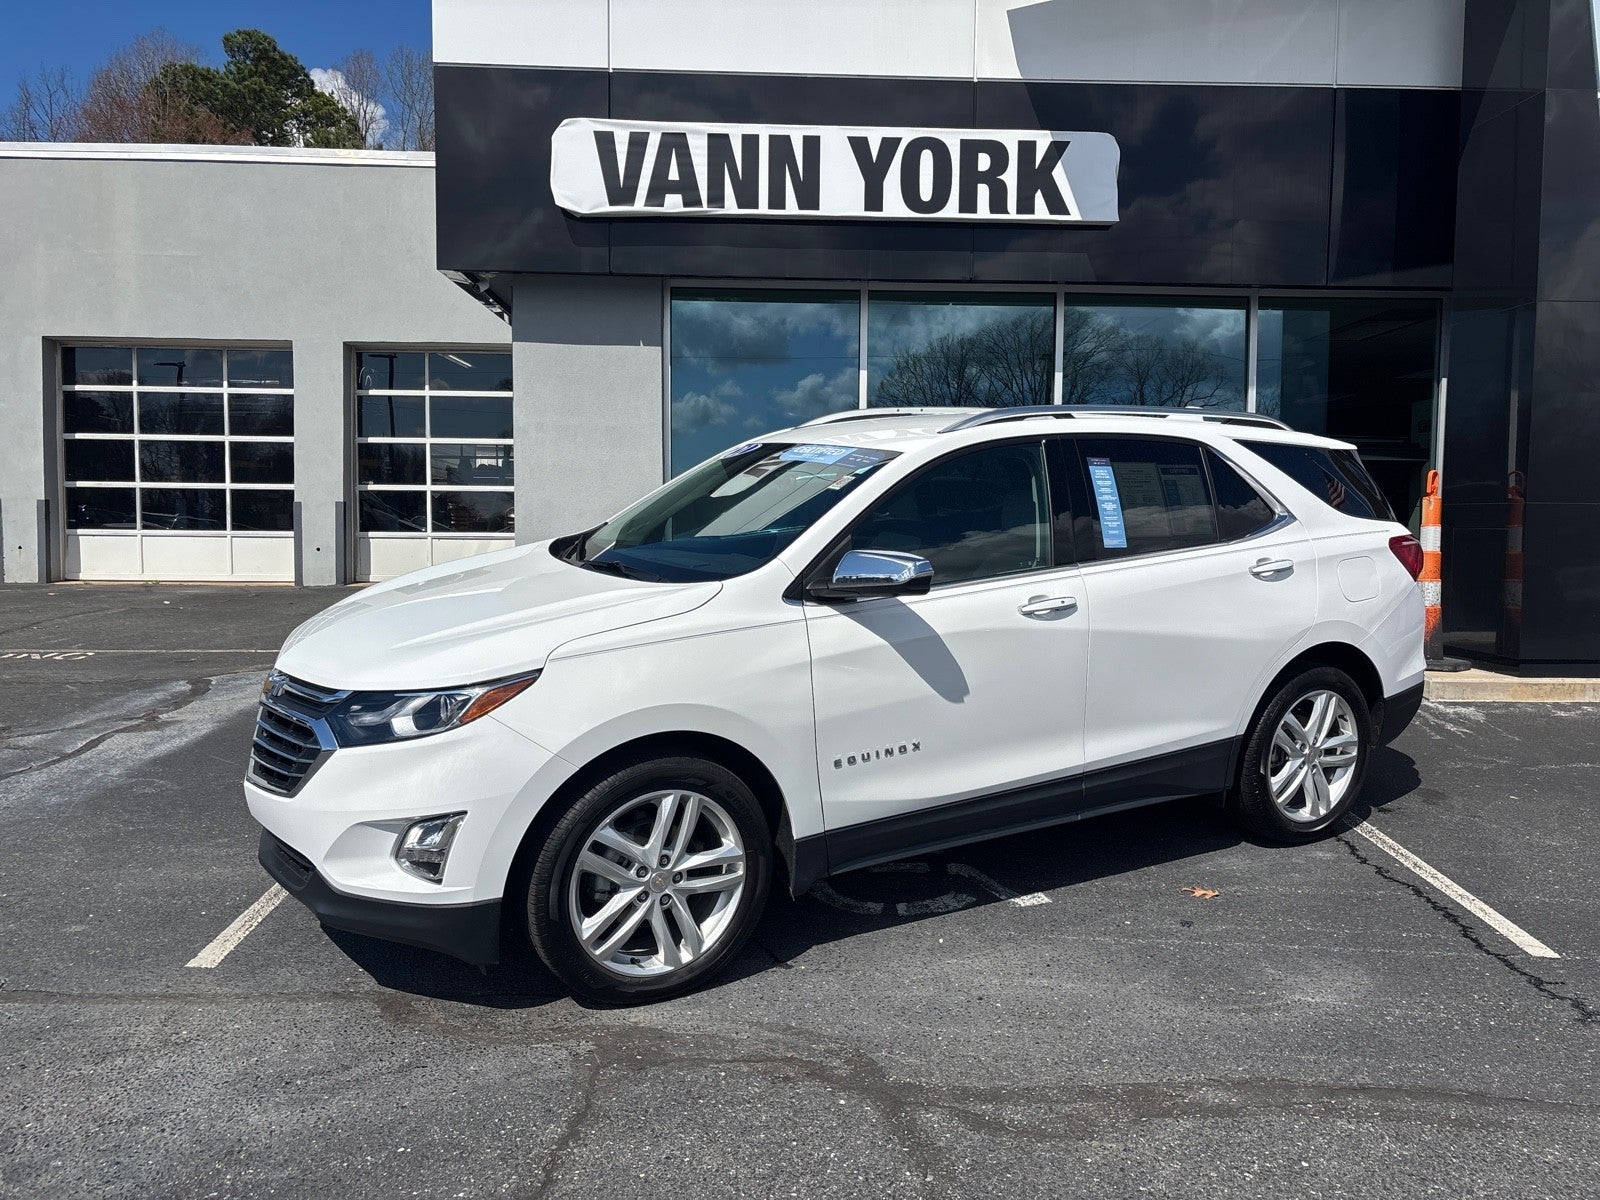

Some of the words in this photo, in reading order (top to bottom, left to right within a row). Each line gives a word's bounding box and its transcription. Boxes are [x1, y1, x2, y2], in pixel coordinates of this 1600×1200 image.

[593, 130, 821, 211] VANN
[847, 136, 1072, 216] YORK
[833, 741, 921, 770] EQUINOX
